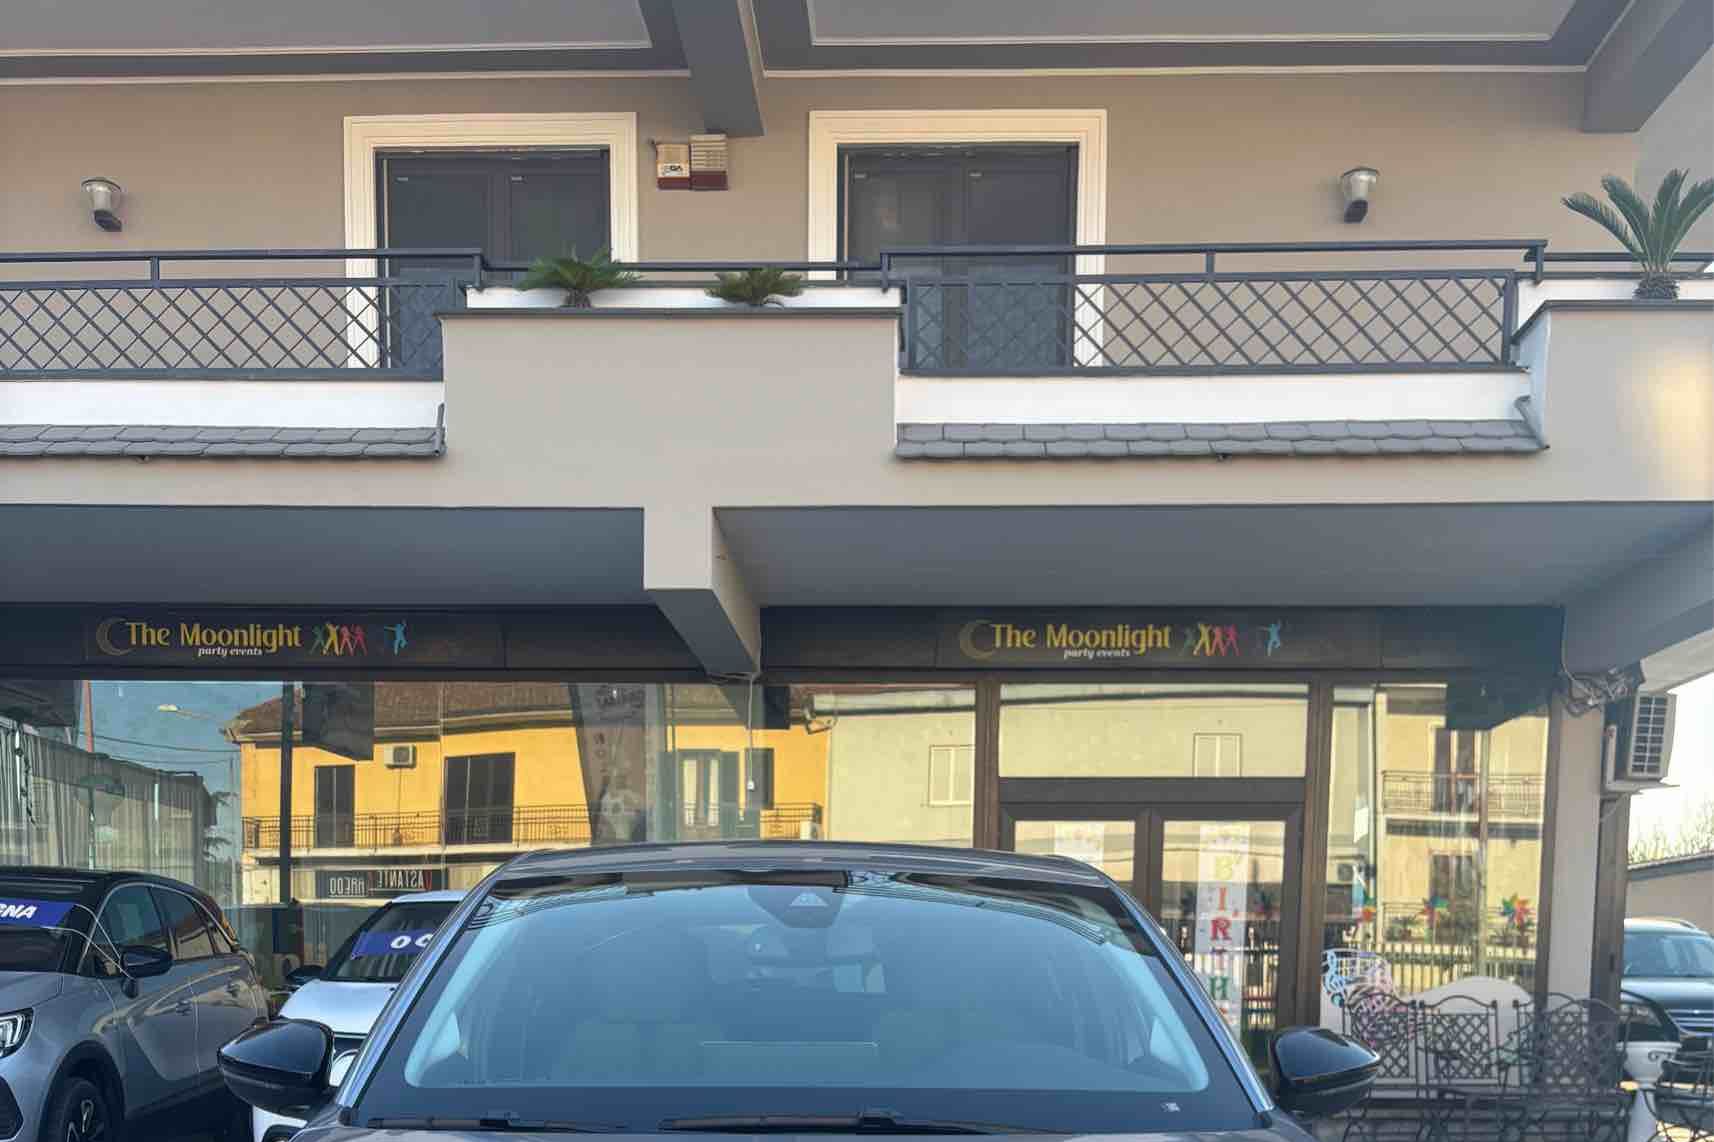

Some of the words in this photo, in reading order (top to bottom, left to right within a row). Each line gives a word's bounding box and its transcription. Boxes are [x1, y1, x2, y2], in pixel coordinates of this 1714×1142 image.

[125, 622, 170, 646] The
[179, 623, 303, 652] Moonlight
[991, 623, 1035, 648] The
[1046, 624, 1171, 653] Moonlight
[197, 646, 228, 657] party
[230, 647, 263, 656] events
[1063, 648, 1094, 660] party
[1097, 649, 1131, 658] events
